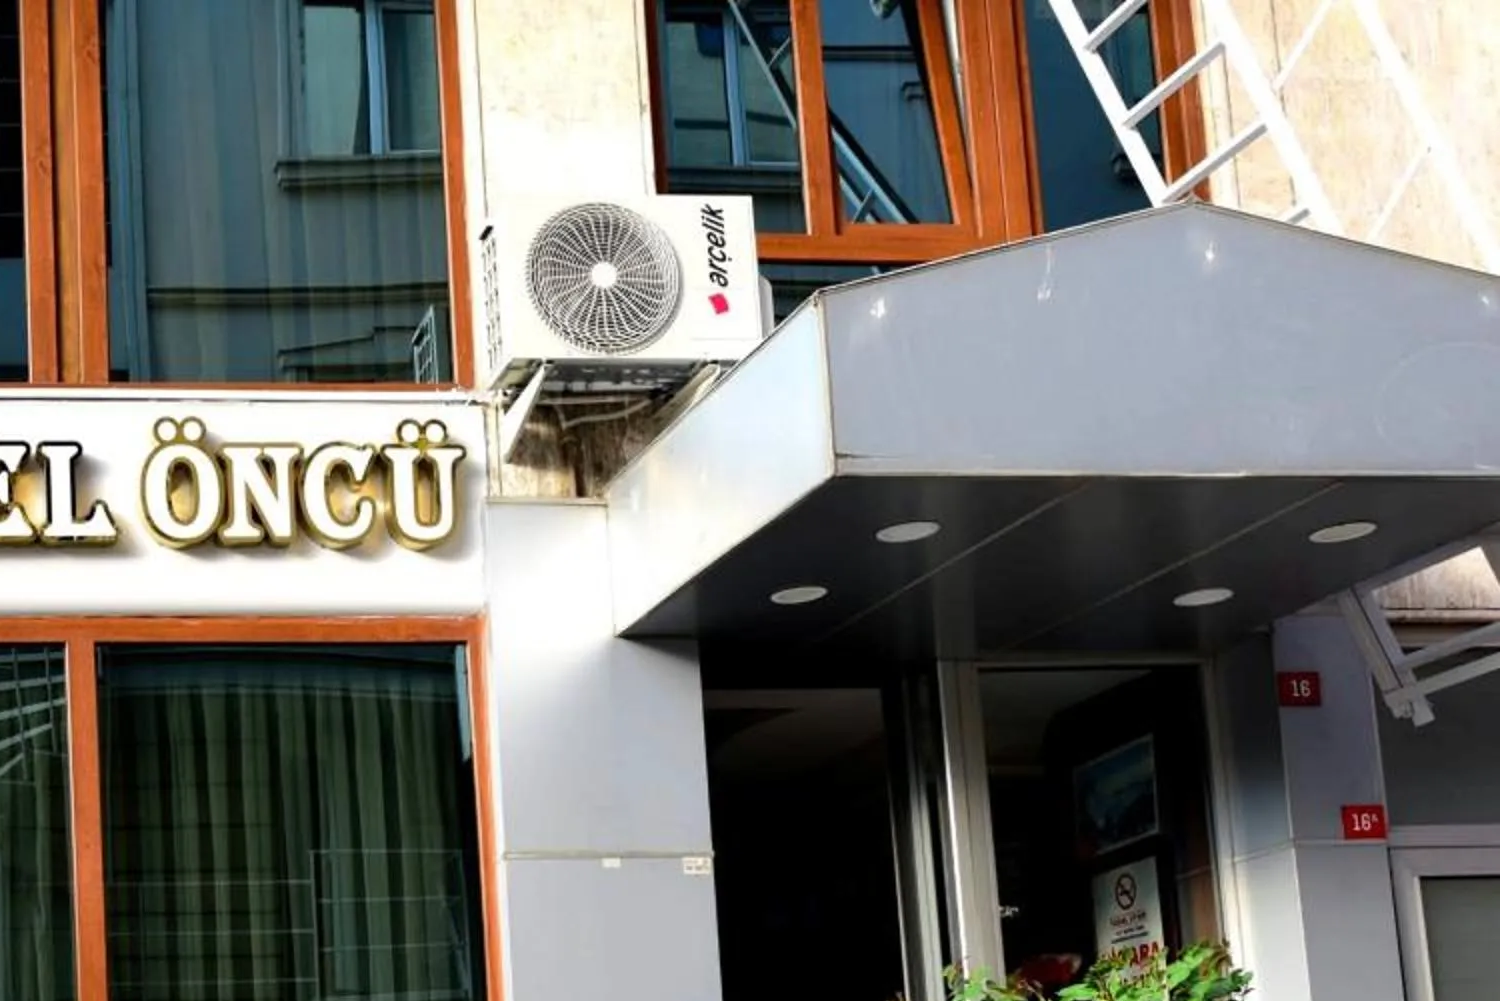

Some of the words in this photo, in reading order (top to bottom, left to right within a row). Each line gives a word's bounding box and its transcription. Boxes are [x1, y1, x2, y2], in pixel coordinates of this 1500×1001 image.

[701, 203, 732, 288] arçelik
[140, 416, 467, 549] ÖNCÜ
[1290, 679, 1311, 697] 16
